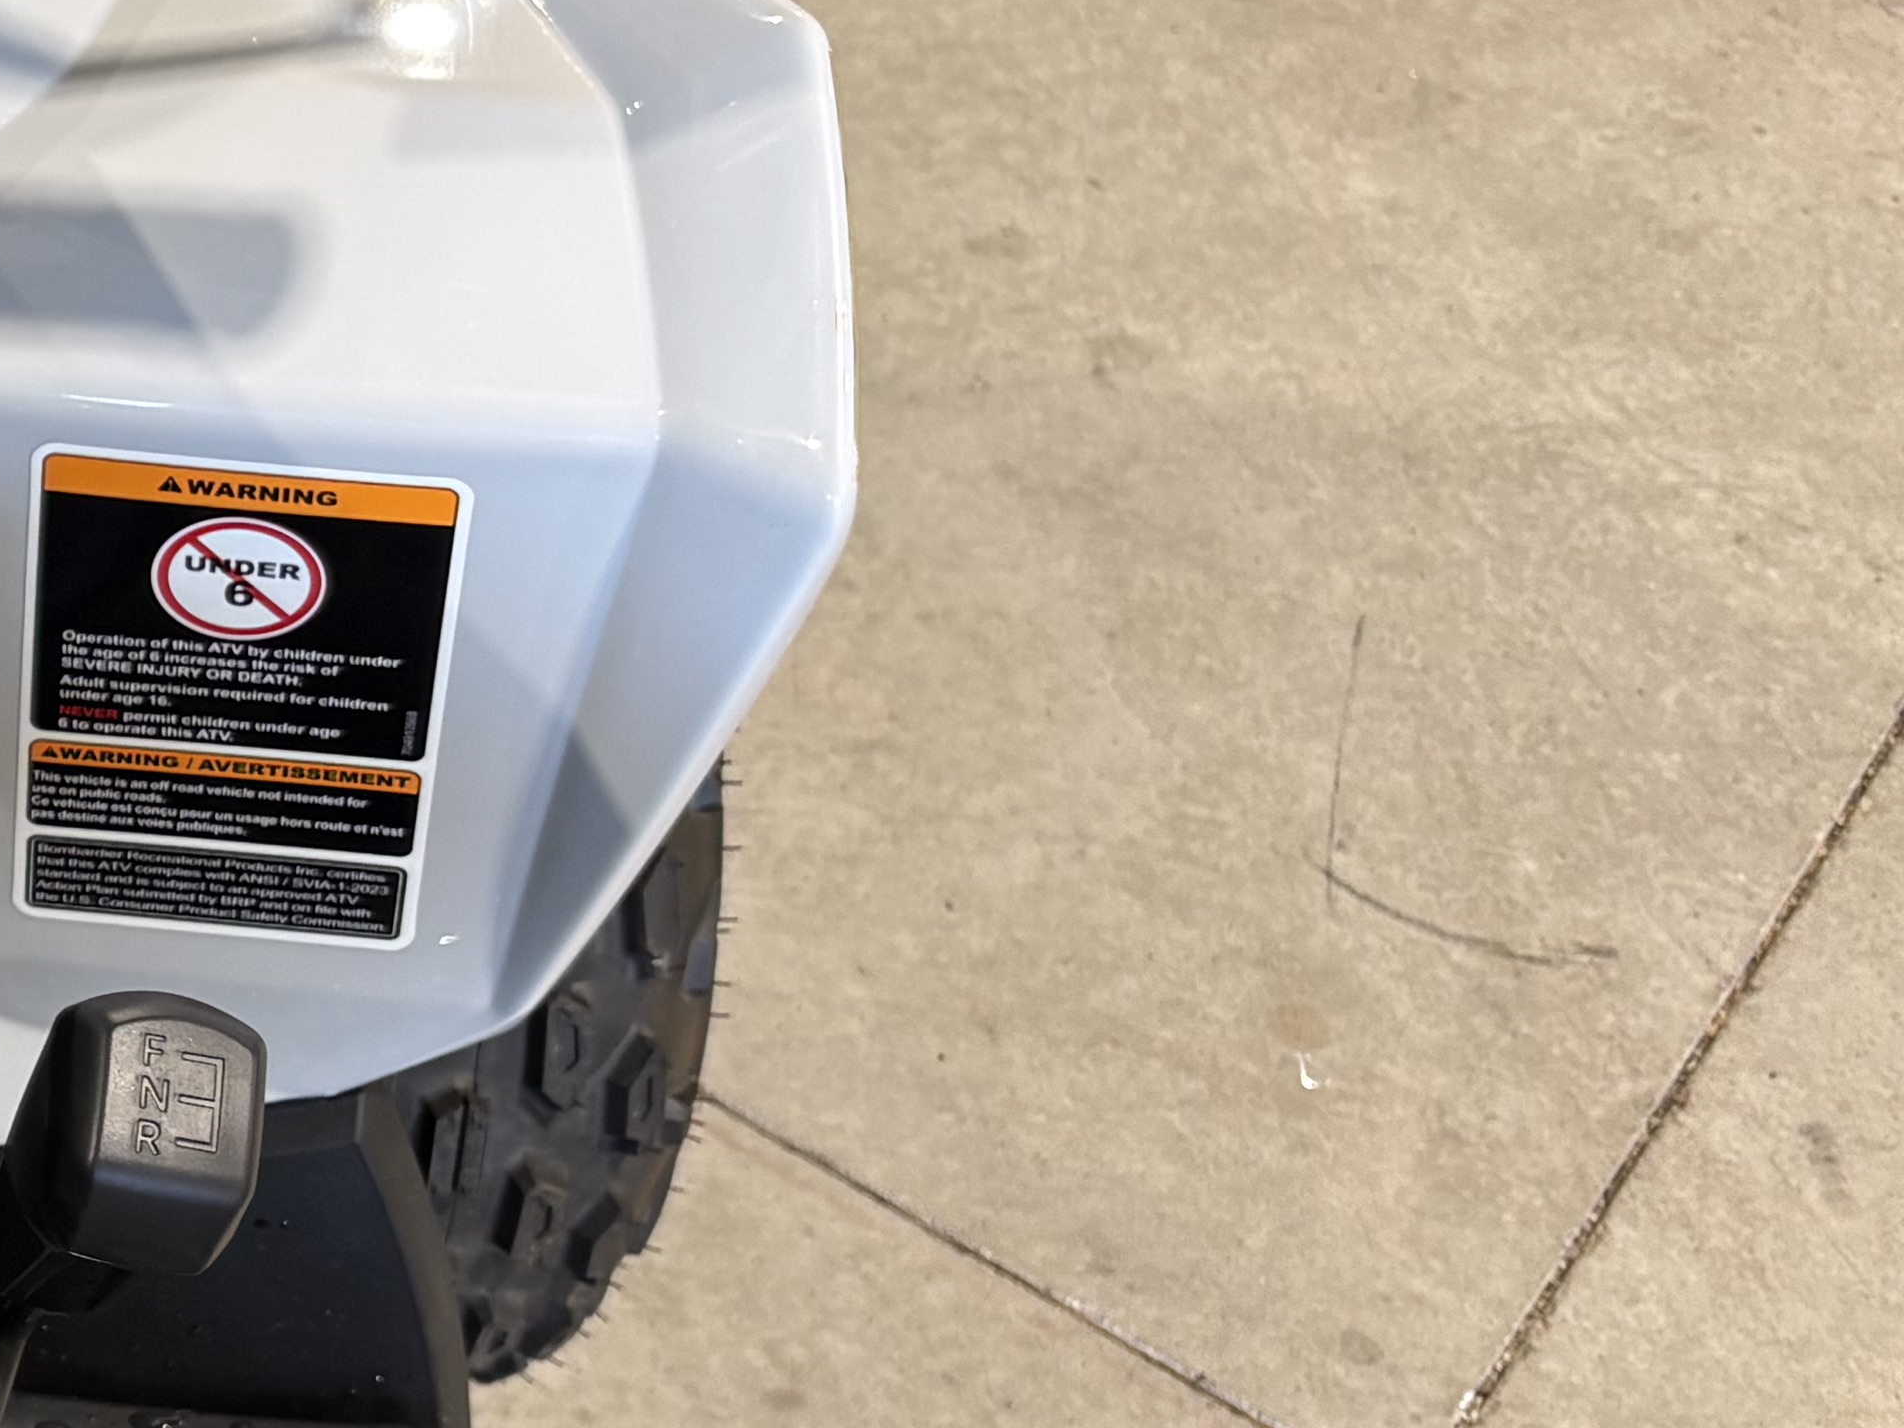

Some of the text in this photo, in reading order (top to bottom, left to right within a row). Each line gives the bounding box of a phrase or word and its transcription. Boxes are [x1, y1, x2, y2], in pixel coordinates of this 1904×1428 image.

[186, 478, 338, 507] WARNING
[184, 554, 300, 581] UNDER
[224, 579, 254, 607] 6
[60, 655, 302, 686] SEVERE INJURY OR DEATH.
[60, 746, 179, 768] WARNING
[197, 758, 410, 789] AVERTISSEMENT
[142, 1032, 167, 1066] F
[139, 1074, 170, 1113] N
[135, 1118, 161, 1155] R
